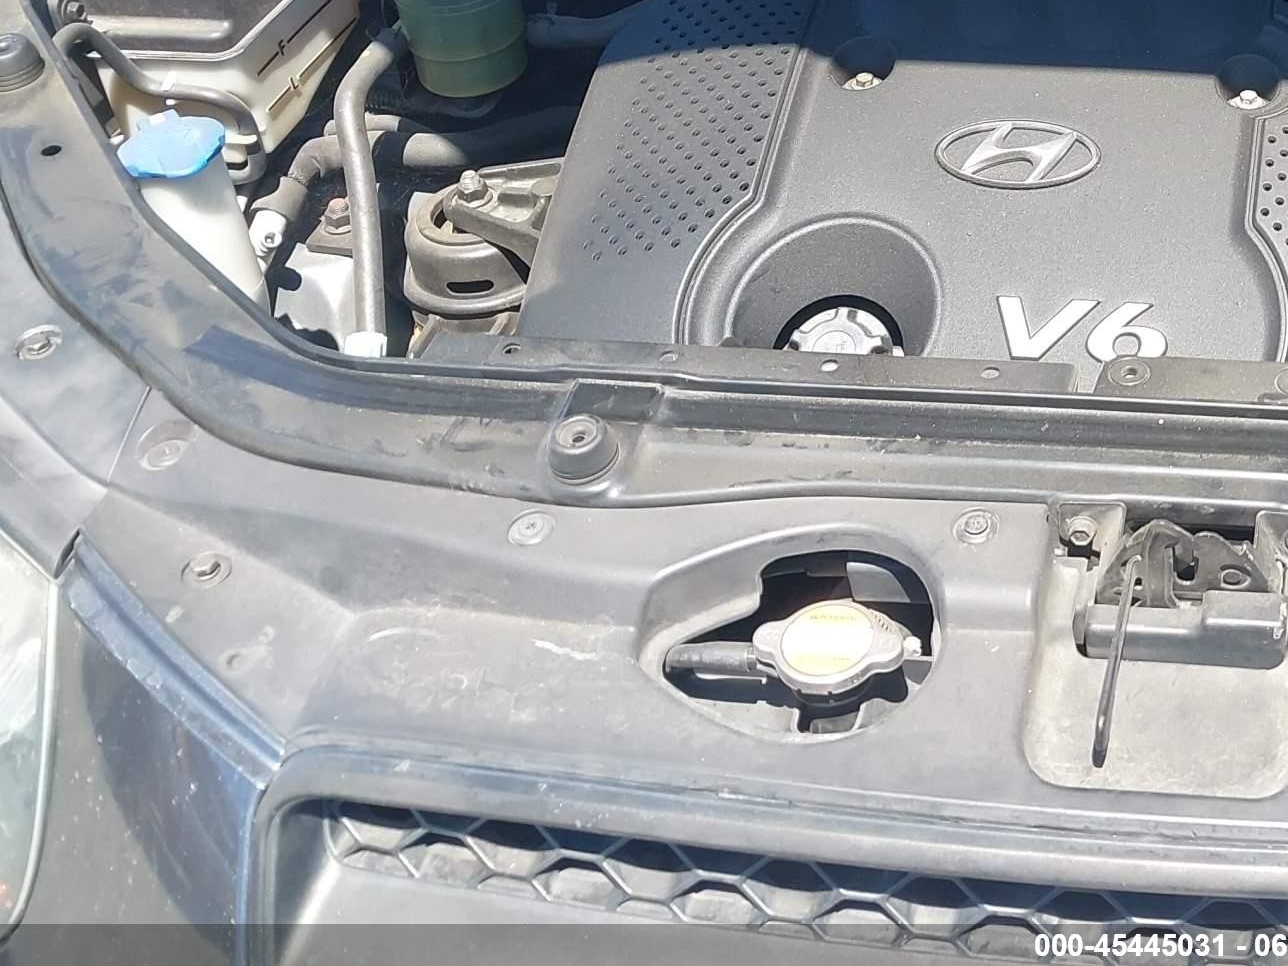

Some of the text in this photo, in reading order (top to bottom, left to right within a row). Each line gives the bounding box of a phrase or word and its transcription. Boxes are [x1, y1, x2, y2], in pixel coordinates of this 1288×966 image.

[278, 39, 285, 56] F
[289, 76, 300, 90] L
[996, 295, 1169, 364] V6
